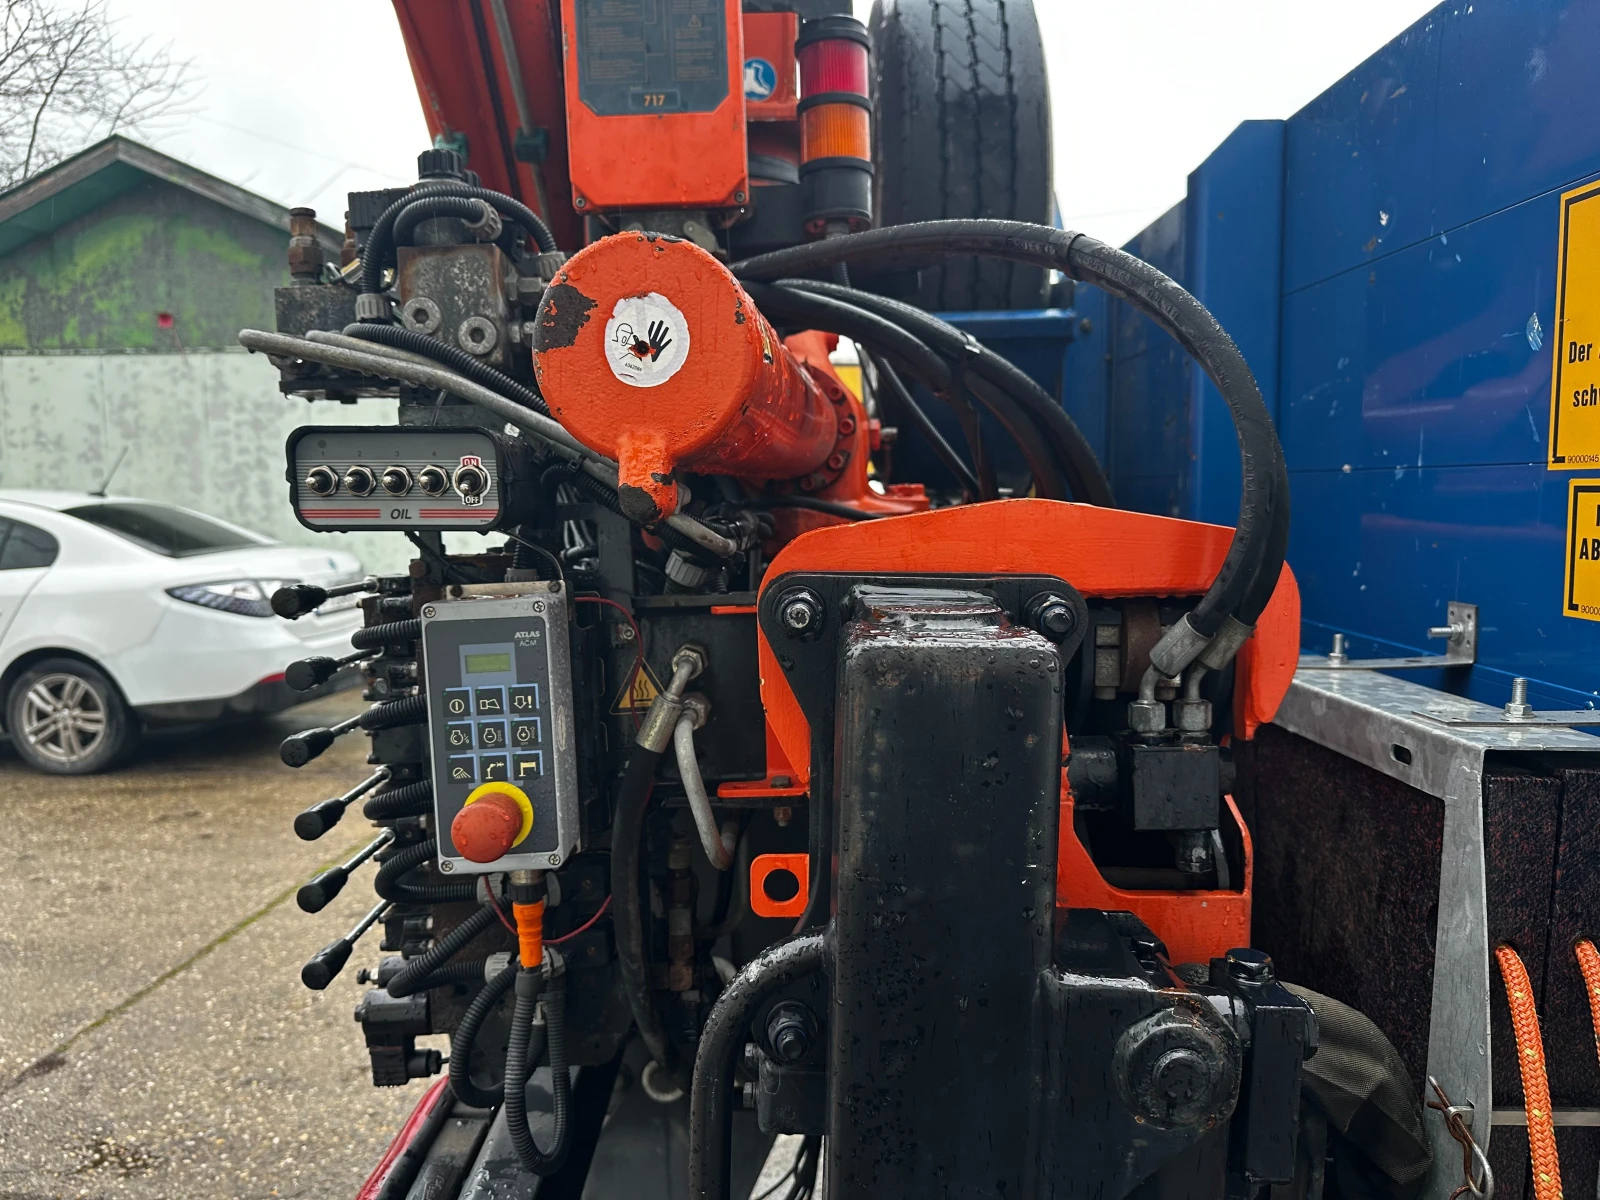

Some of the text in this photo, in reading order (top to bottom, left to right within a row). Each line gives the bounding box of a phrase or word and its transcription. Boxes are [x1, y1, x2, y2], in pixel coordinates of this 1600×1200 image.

[644, 94, 666, 107] 717
[1568, 341, 1592, 364] Der
[1572, 384, 1600, 408] sch
[464, 458, 477, 466] ON
[465, 496, 479, 504] OFF
[390, 508, 412, 520] OIL
[514, 630, 540, 638] ATLAS
